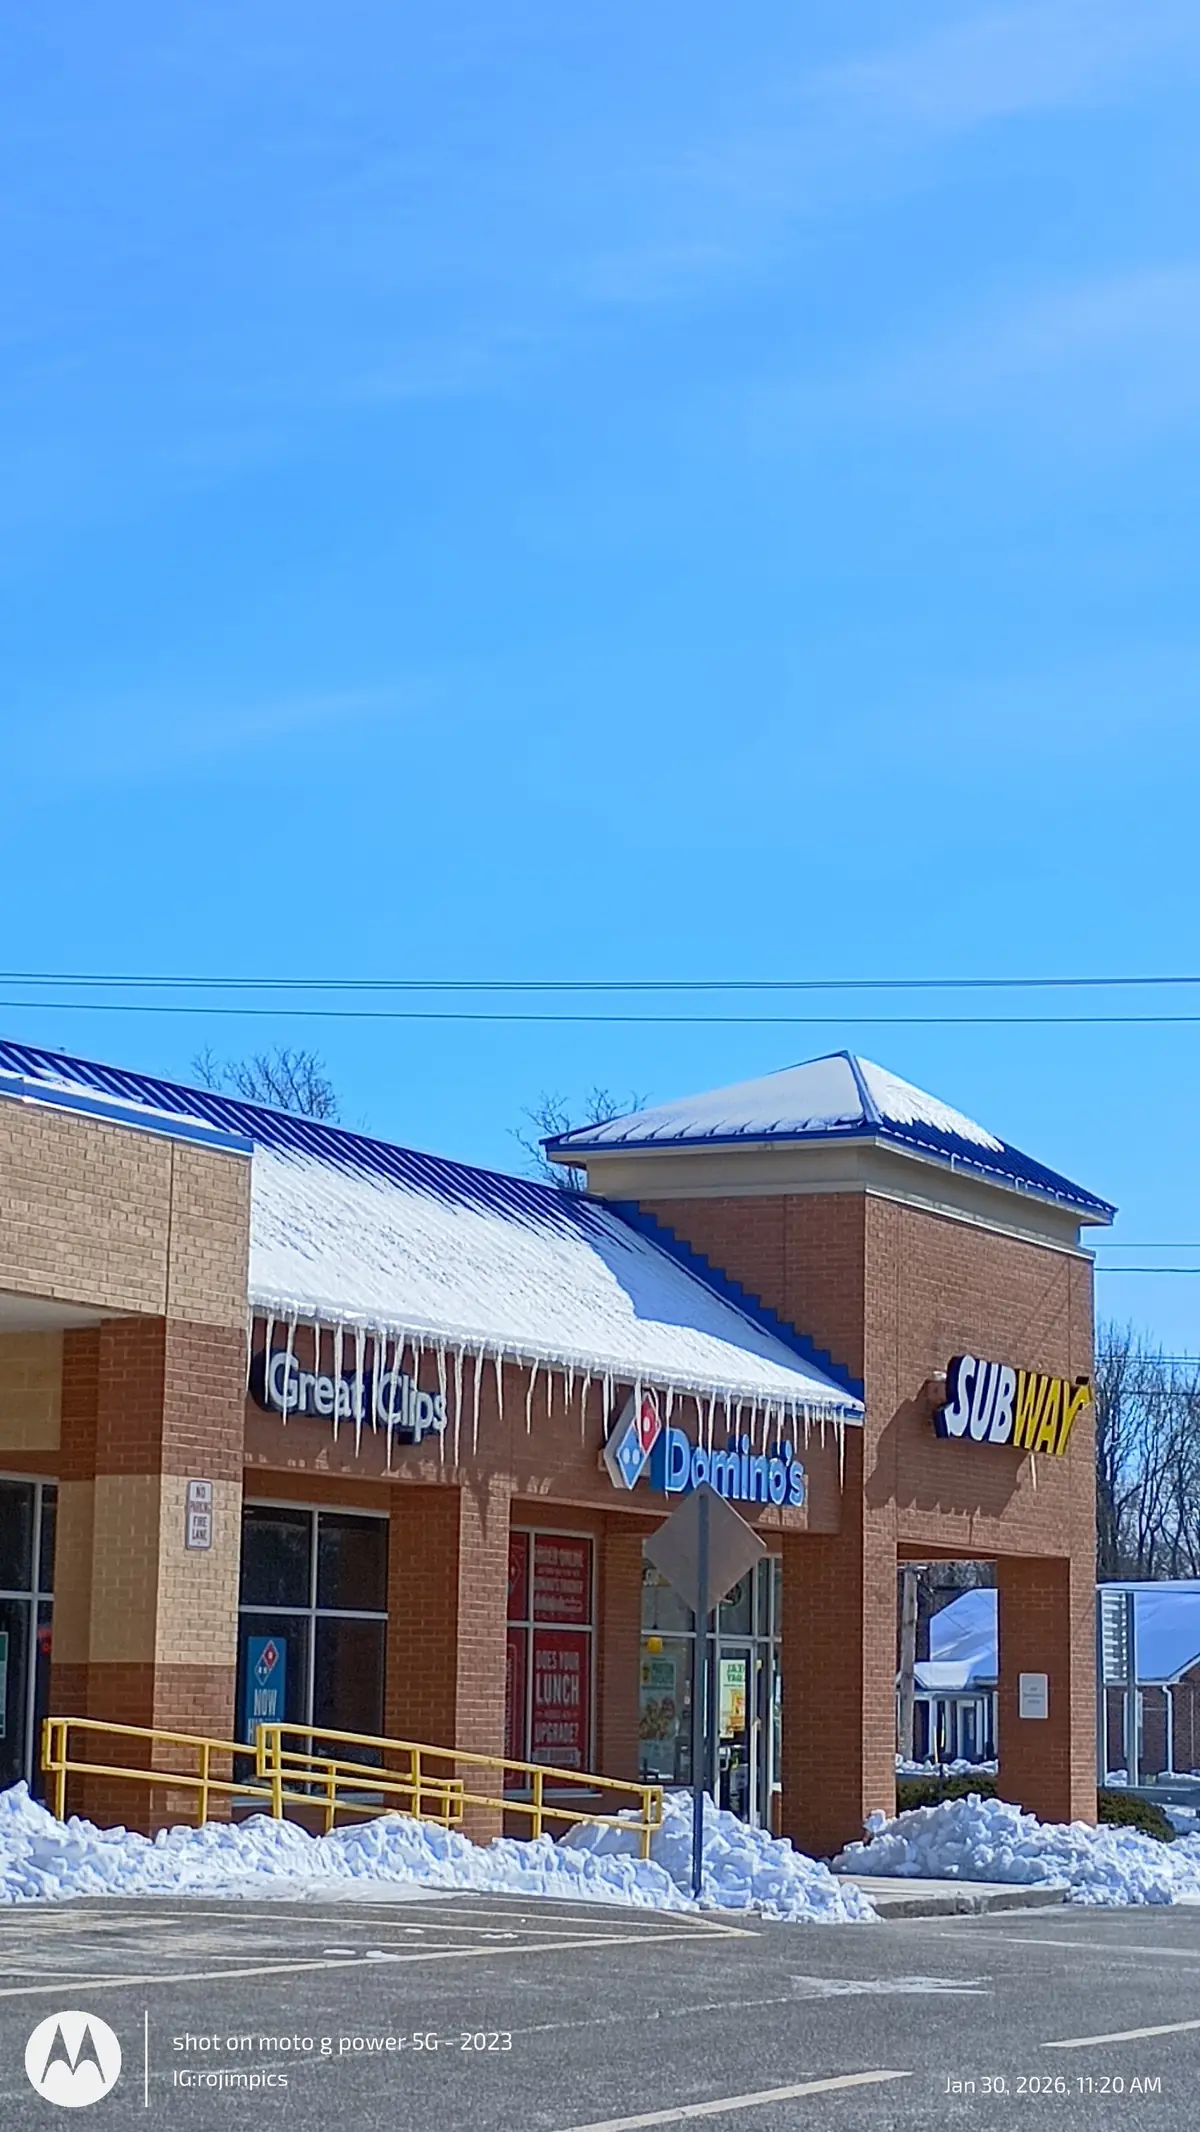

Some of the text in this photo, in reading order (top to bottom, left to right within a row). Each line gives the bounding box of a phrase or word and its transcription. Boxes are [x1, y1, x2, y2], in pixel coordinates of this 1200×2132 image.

[268, 1352, 447, 1443] Great Clips
[944, 1354, 1091, 1456] SUBWAY
[664, 1427, 806, 1507] Domino's
[195, 1486, 206, 1499] NO
[192, 1528, 208, 1541] LANE
[193, 1515, 208, 1528] FIRE
[253, 1688, 277, 1717] NOW
[535, 1673, 580, 1706] LUNCH
